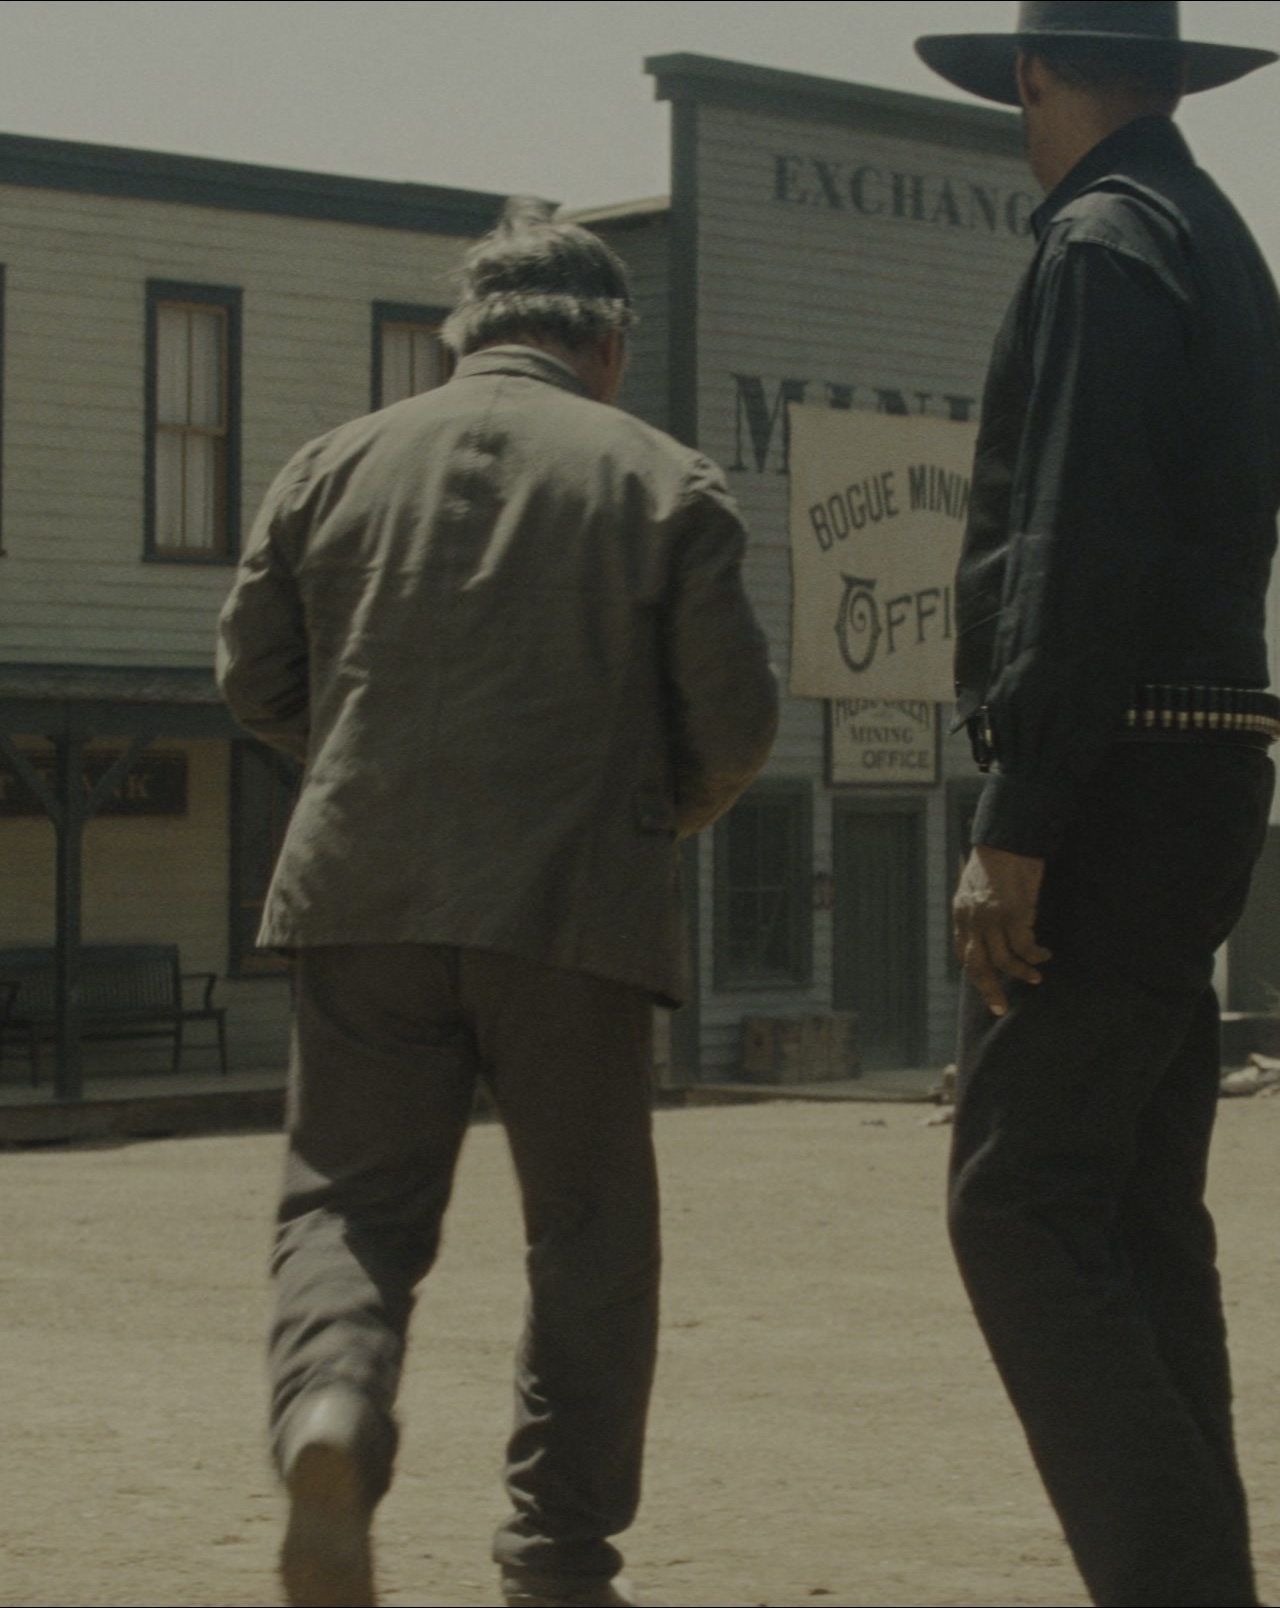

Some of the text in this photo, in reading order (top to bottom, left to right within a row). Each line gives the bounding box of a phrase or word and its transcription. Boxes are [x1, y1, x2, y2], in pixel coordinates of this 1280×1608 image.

[808, 470, 900, 552] BOGUE
[850, 725, 913, 744] MINING
[861, 749, 930, 769] OFFICE
